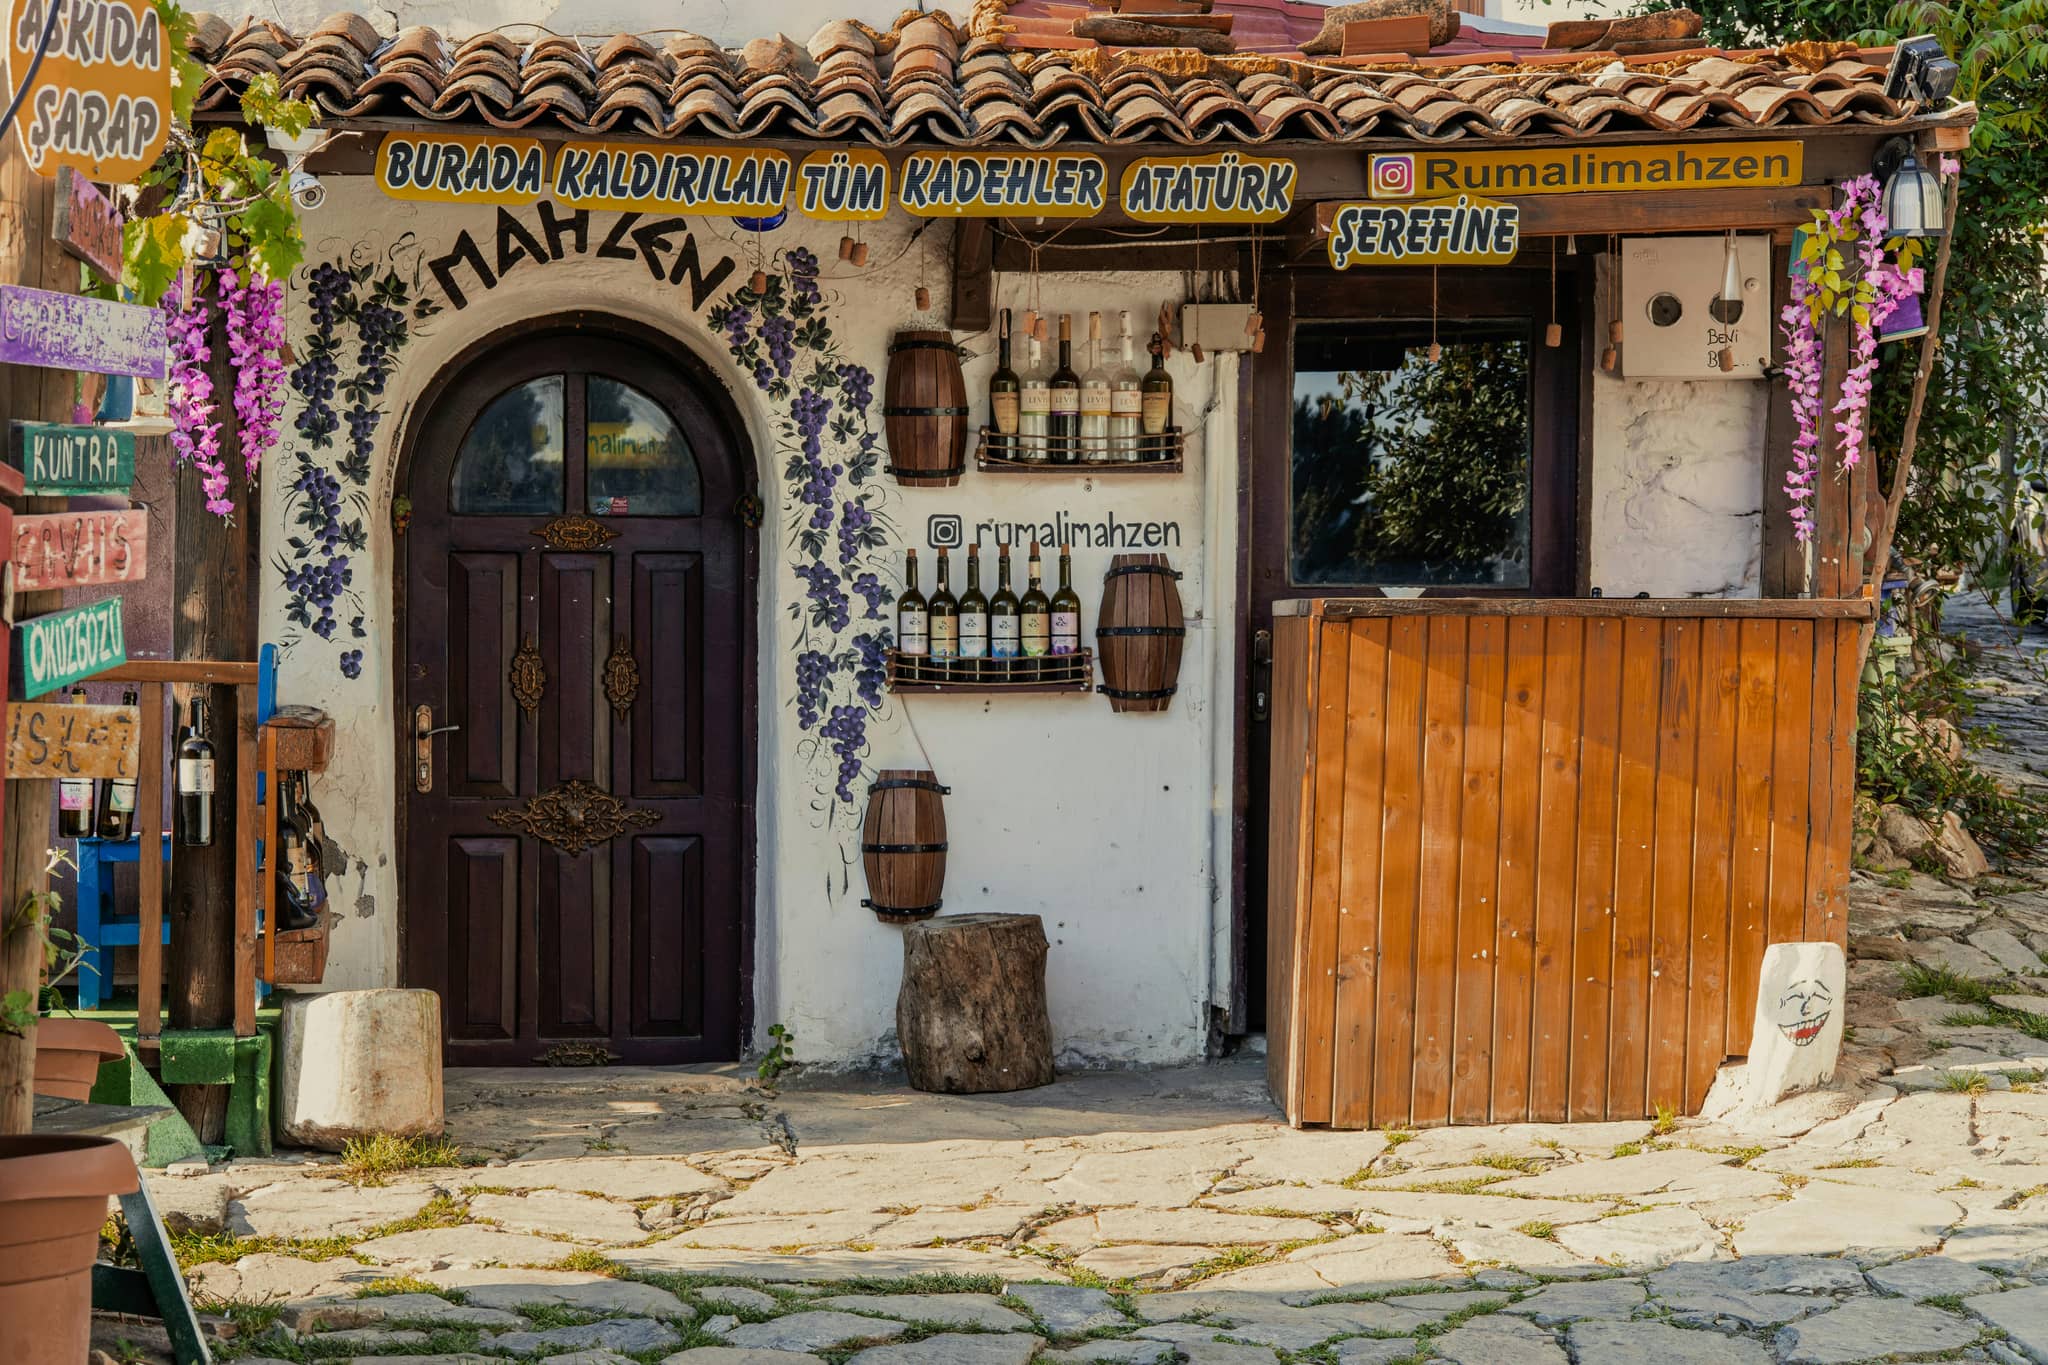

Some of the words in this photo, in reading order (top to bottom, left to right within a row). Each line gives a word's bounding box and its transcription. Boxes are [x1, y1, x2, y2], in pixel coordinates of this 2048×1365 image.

[29, 86, 159, 167] ŞARAP
[387, 140, 542, 194] BURADA
[557, 148, 789, 206] KALDIRILAN
[802, 153, 885, 211] TÜM
[902, 157, 1103, 208] KADEHLER
[1128, 153, 1294, 213] ATATÜRK
[1426, 150, 1790, 190] Rumalimahzen
[428, 200, 736, 312] MAHZEN
[1334, 196, 1518, 267] ŞEREFİNE
[33, 434, 118, 482] KUNTRA
[975, 510, 1181, 548] rumalimahzen
